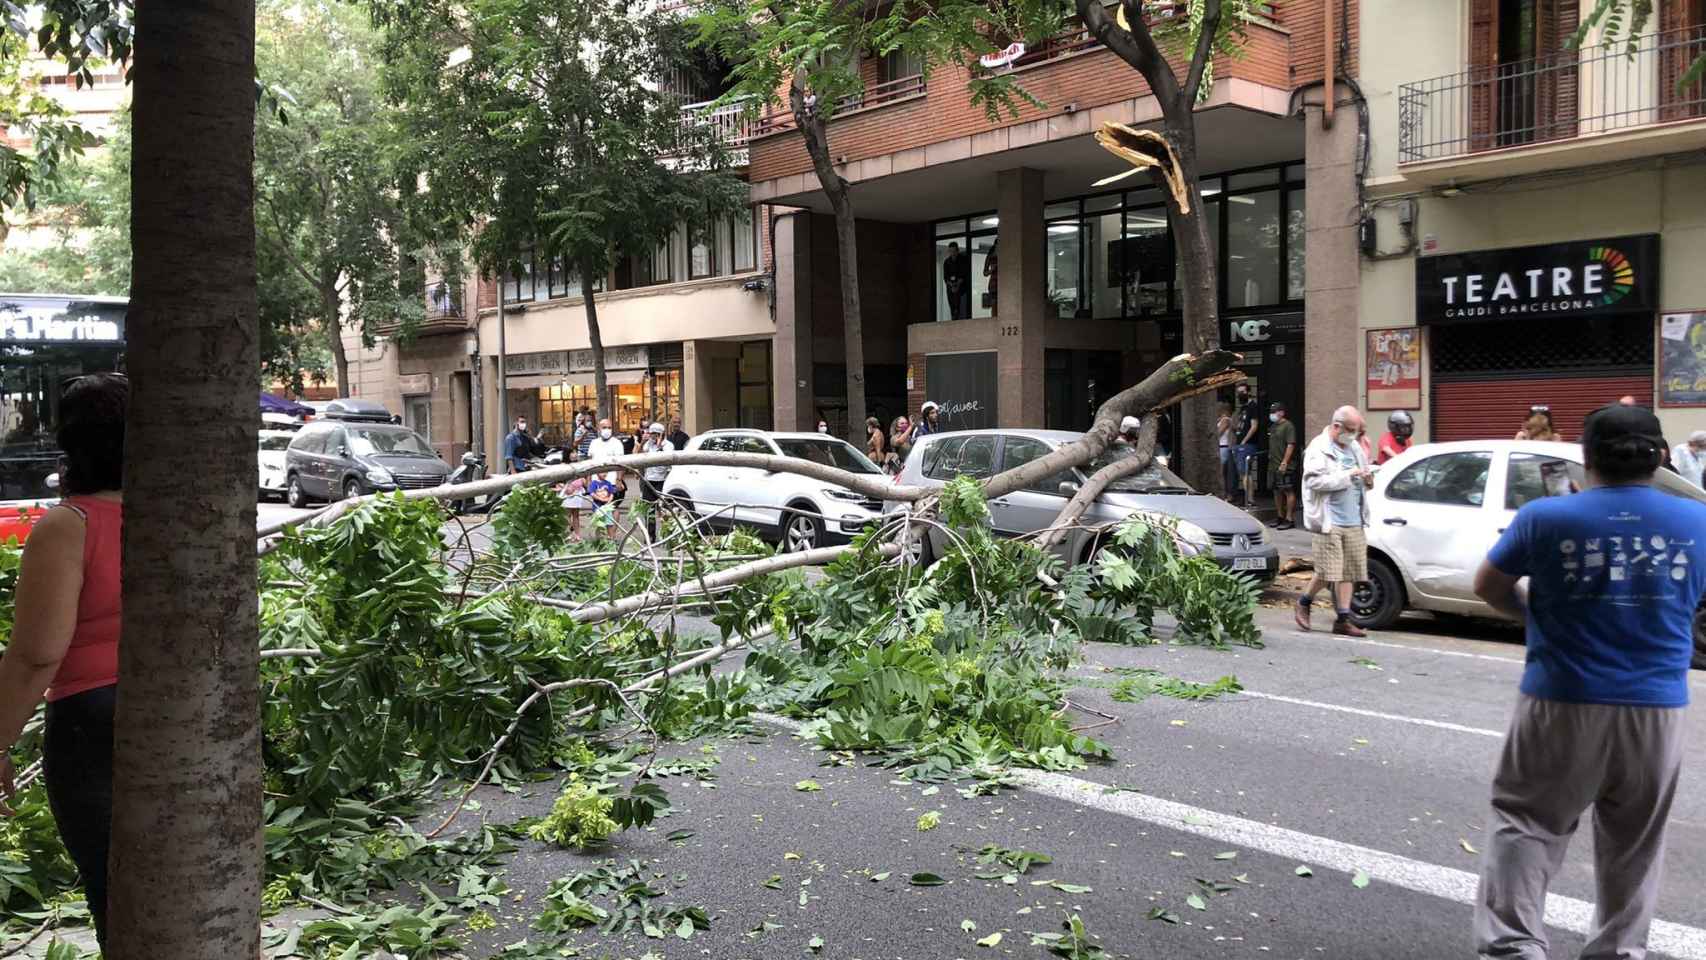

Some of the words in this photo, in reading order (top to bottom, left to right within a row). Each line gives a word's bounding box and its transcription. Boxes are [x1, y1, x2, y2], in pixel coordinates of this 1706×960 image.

[1442, 264, 1603, 305] TEATRE
[1446, 308, 1492, 319] GAUDI
[1500, 300, 1594, 315] BARCELONA
[1001, 326, 1018, 337] 122
